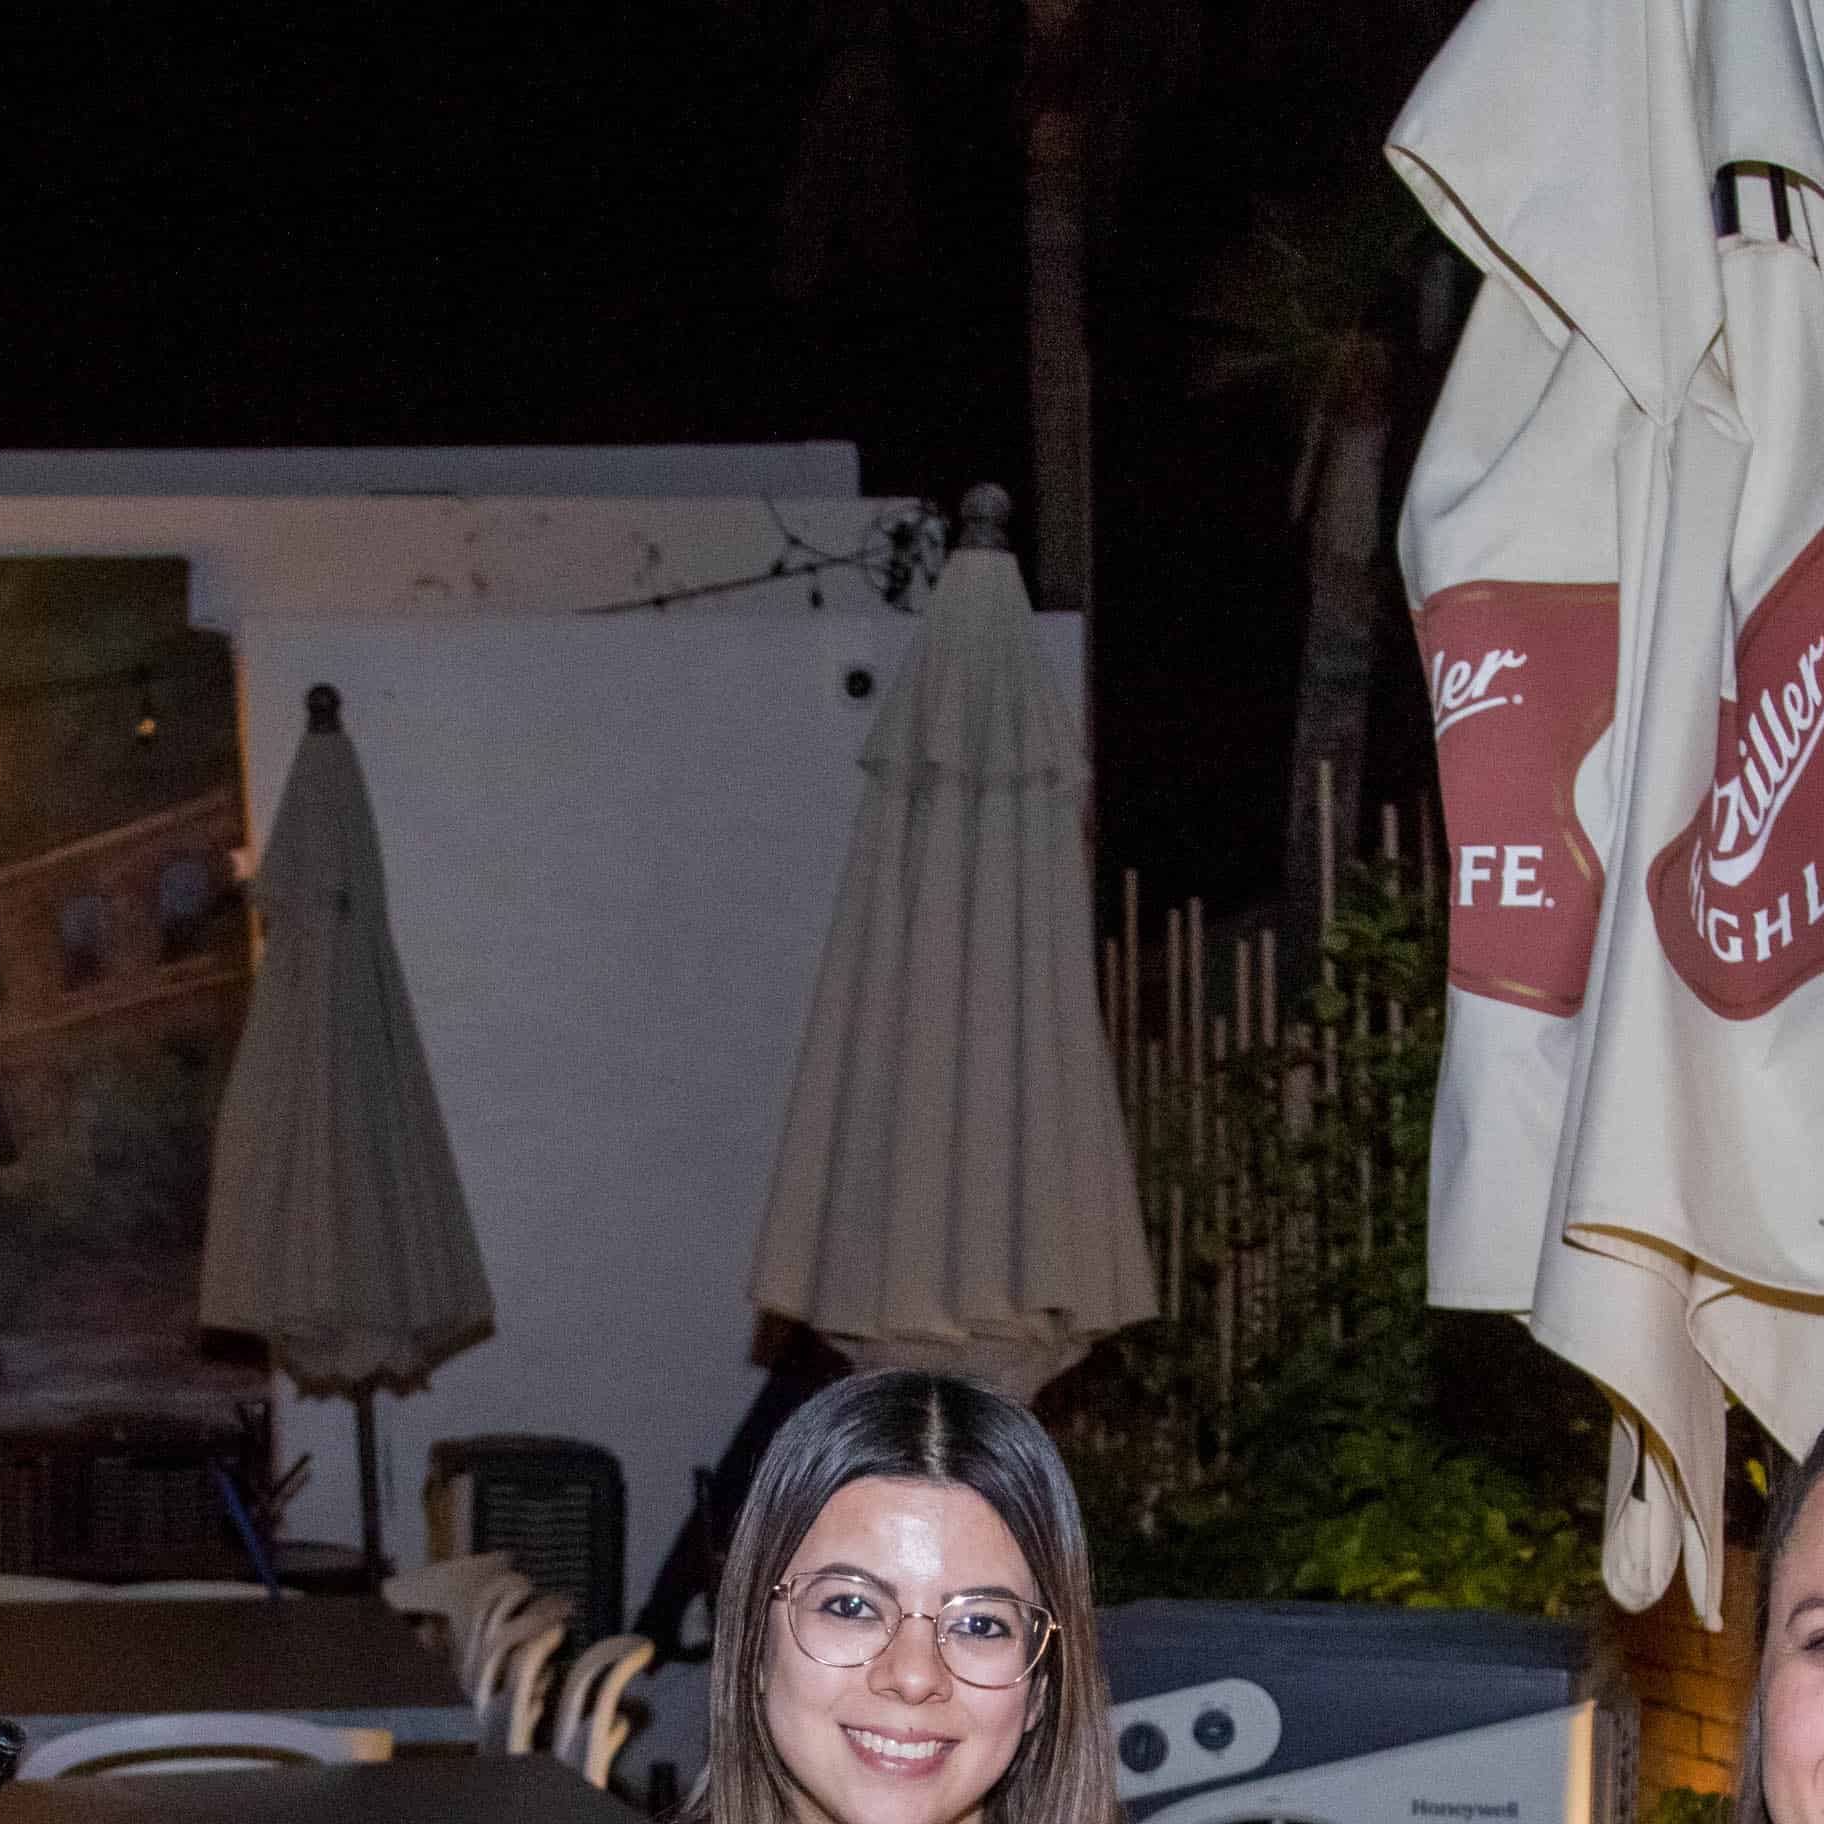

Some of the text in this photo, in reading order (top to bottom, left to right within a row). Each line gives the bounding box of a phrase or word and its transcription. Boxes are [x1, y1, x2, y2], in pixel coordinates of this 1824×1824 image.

[1432, 648, 1527, 726] ler
[1459, 845, 1555, 907] FE.
[1689, 834, 1794, 963] HIGH
[1411, 1798, 1519, 1822] Honeywell
